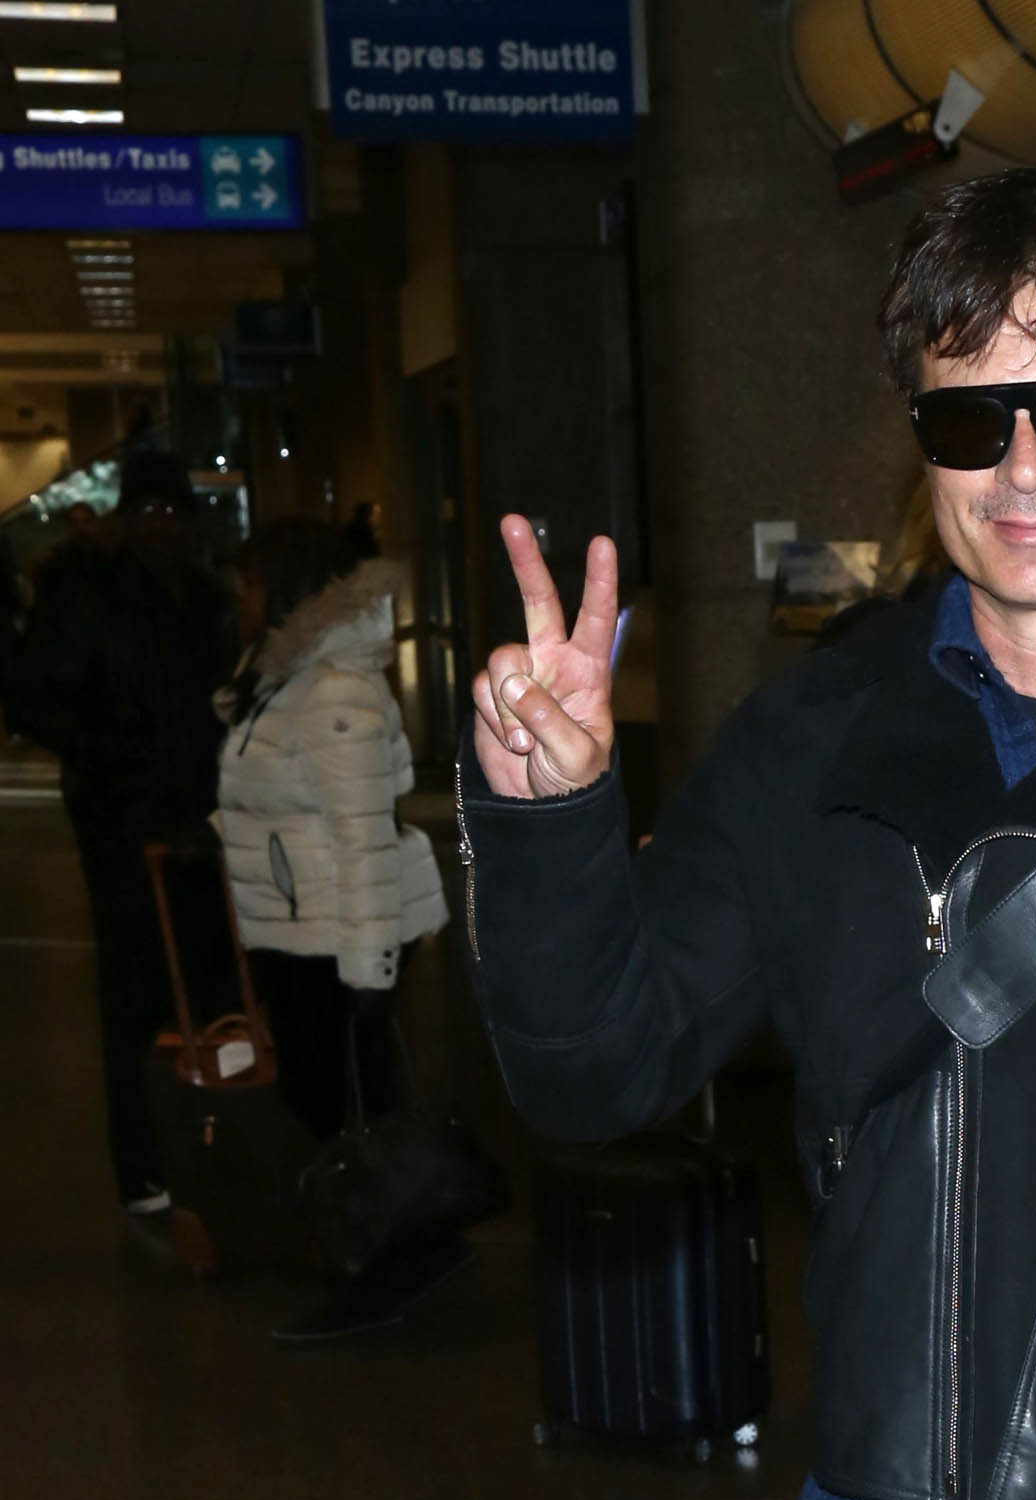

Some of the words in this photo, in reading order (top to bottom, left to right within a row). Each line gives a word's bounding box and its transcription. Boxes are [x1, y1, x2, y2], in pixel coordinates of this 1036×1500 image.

[350, 38, 486, 75] Express
[498, 41, 618, 73] Shuttle
[345, 88, 435, 116] Canyon
[442, 90, 621, 117] Transportation
[103, 184, 153, 206] Local
[159, 186, 193, 206] Bus
